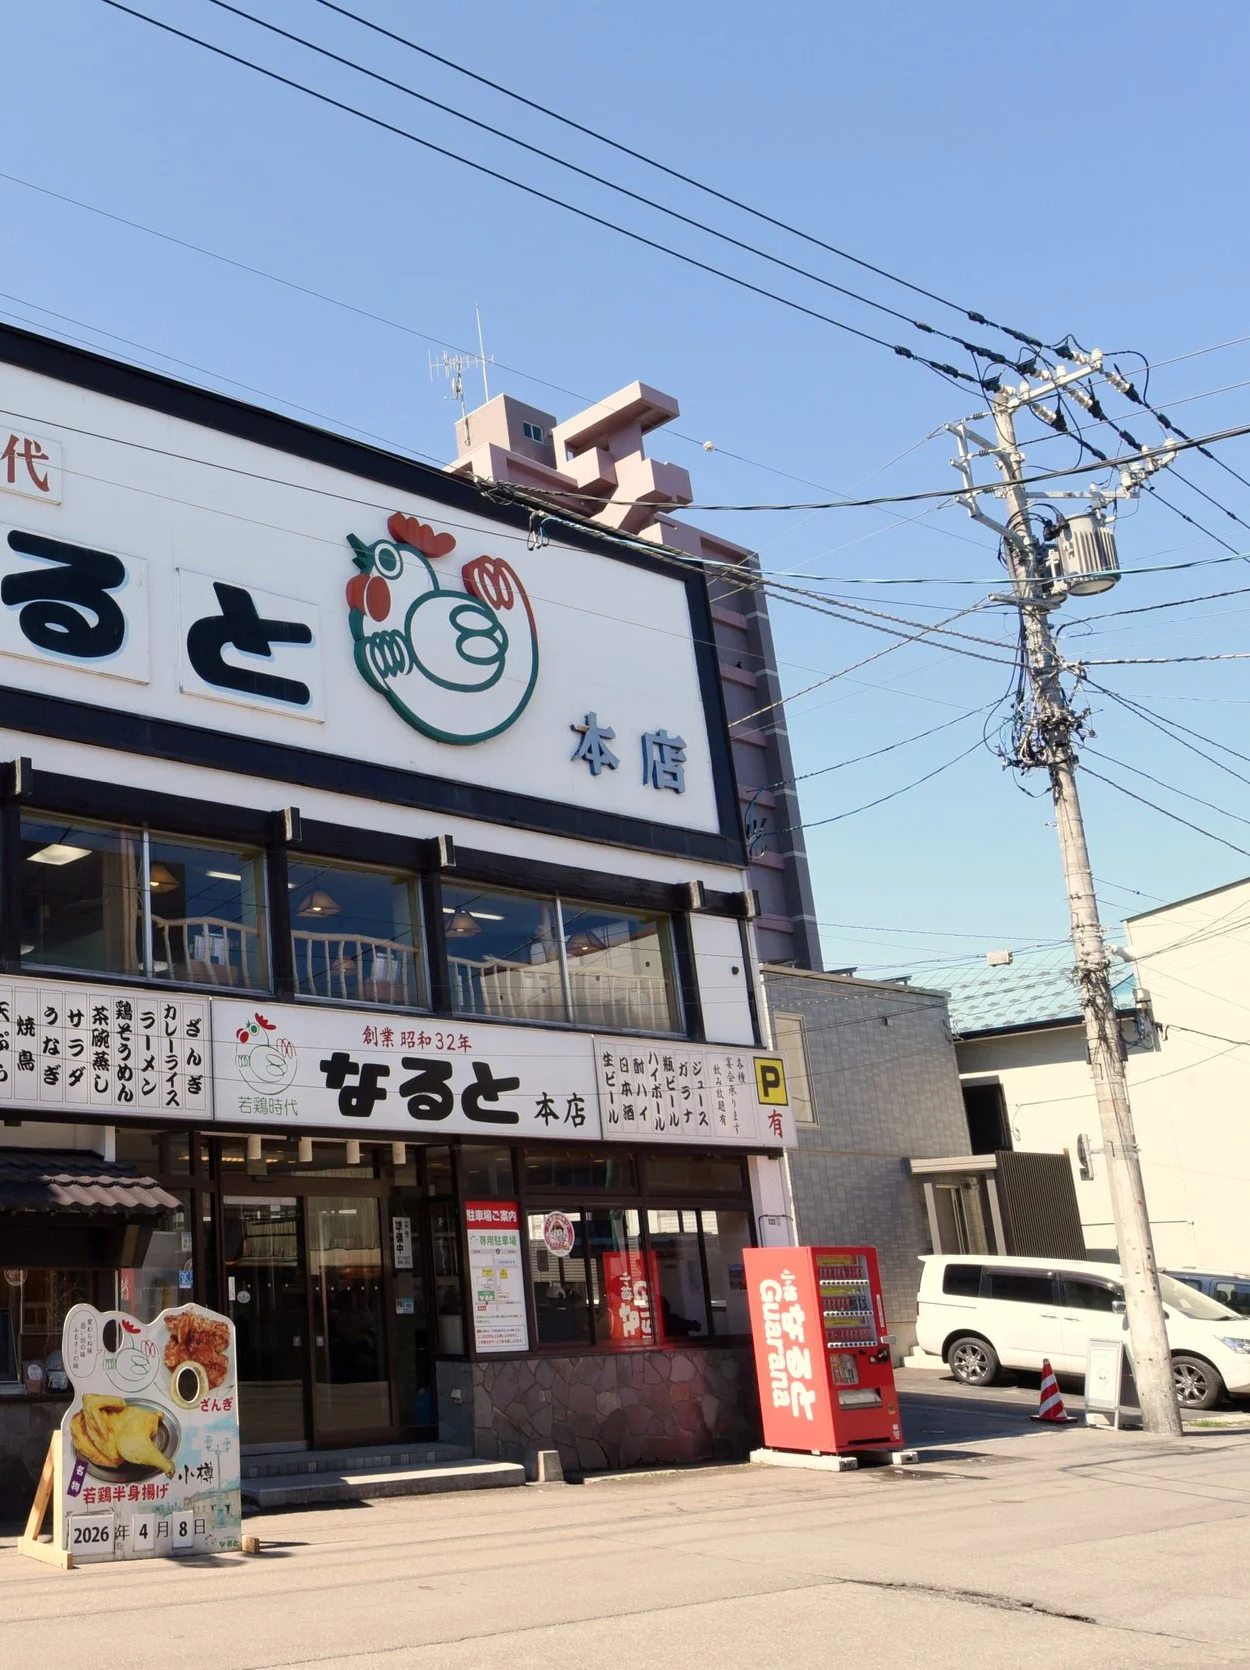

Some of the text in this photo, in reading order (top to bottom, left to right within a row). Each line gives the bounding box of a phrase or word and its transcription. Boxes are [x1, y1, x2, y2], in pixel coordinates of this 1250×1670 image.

[569, 710, 688, 795] 本店
[16, 1015, 36, 1072] 焼鳥
[42, 1006, 61, 1086] うなぎ
[67, 1009, 85, 1088] サラダ
[91, 1006, 110, 1094] 茶碗蒸し
[115, 1000, 134, 1103] 鶏そうめん
[140, 1011, 157, 1096] ラーメン
[163, 1003, 180, 1107] カレーライス
[186, 1018, 202, 1095] ざんぎ
[737, 1058, 746, 1084] 各種
[237, 1096, 299, 1117] 若鶏時代
[319, 1052, 586, 1129] なると 本店
[603, 1051, 619, 1125] 生ビール
[619, 1057, 635, 1121] 日本酒
[633, 1058, 648, 1121] 酎ハイ
[648, 1051, 665, 1131] ハイボール
[663, 1056, 679, 1127] 瓶ビール
[679, 1061, 694, 1124] ガラナ
[692, 1061, 709, 1127] ジュース
[713, 1064, 727, 1126] 飲み放題有
[726, 1057, 740, 1134] 宴会承ります
[760, 1065, 780, 1097] P
[767, 1109, 783, 1139] 有
[466, 1209, 517, 1222] 駐車場ご案内
[759, 1279, 790, 1408] Guarana
[200, 1397, 234, 1412] ざんぎ
[69, 1465, 85, 1494] 名物
[82, 1482, 169, 1504] 若鶏半身揚げ
[178, 1462, 215, 1486] 小樽
